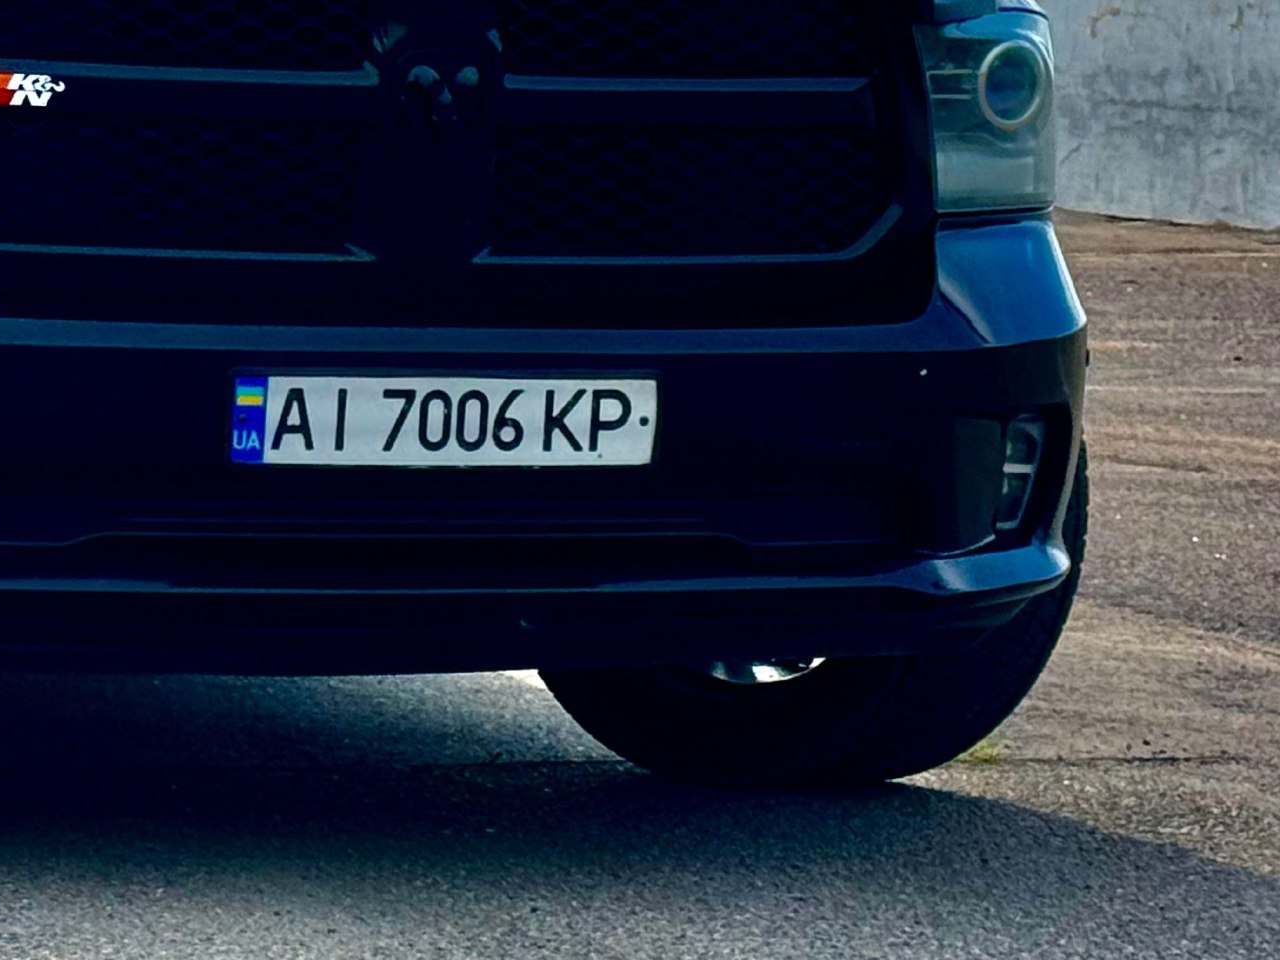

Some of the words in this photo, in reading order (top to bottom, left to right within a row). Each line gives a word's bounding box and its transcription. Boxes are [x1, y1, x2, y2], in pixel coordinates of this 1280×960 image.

[232, 429, 261, 449] UA
[382, 389, 525, 452] 7006
[542, 389, 632, 452] KP
